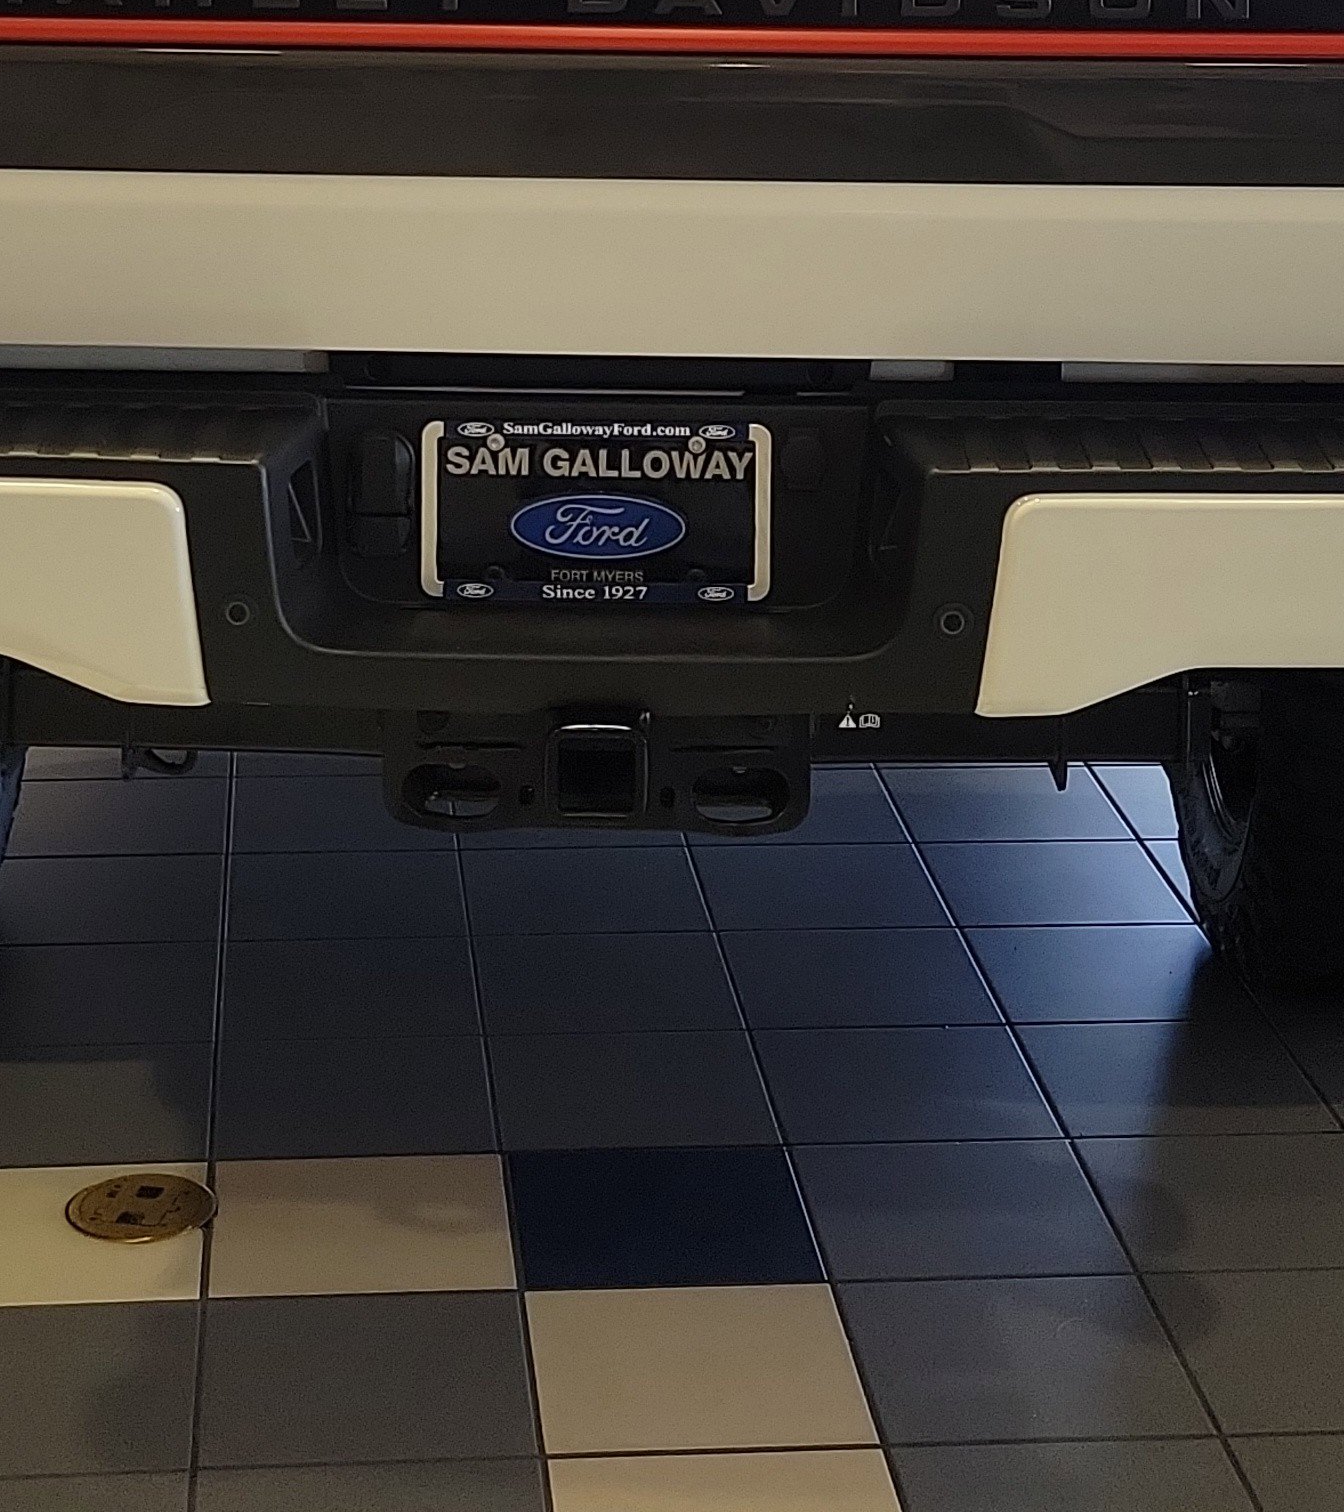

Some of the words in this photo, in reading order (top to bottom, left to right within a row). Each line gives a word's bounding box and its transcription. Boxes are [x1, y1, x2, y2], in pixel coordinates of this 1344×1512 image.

[503, 422, 691, 438] SamGallowayFord.com
[446, 446, 529, 476] SAM
[543, 448, 753, 480] GALLOWAY
[545, 503, 650, 547] Ford
[551, 569, 589, 582] FORT
[593, 571, 644, 583] MYERS
[542, 585, 596, 600] Since
[603, 586, 648, 600] 1927
